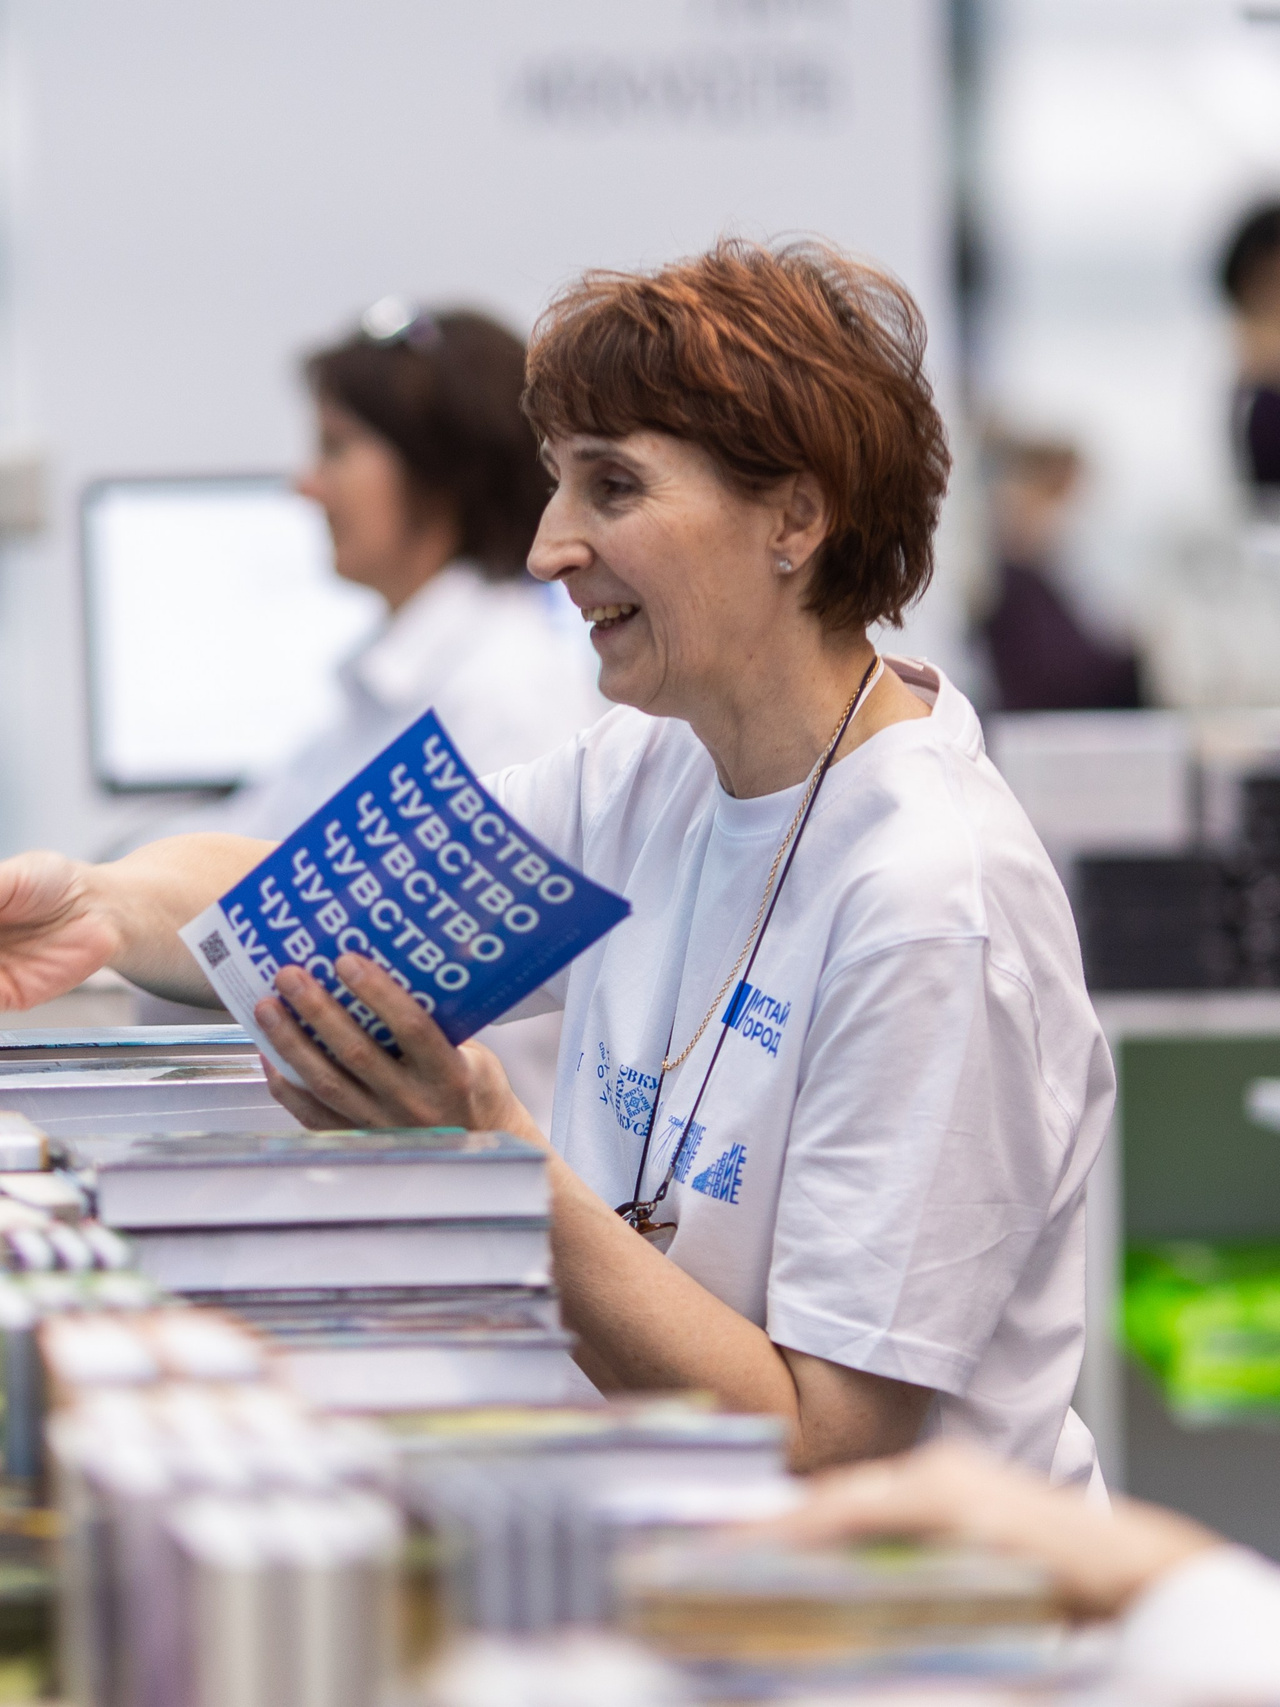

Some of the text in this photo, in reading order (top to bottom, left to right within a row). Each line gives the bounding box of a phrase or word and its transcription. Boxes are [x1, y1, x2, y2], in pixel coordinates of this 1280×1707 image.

[356, 791, 505, 963] ЧУВСТВО
[388, 763, 540, 933] ЧУВСТВО
[421, 733, 575, 905] ЧУВСТВО
[324, 819, 470, 992] ЧУВСТВО
